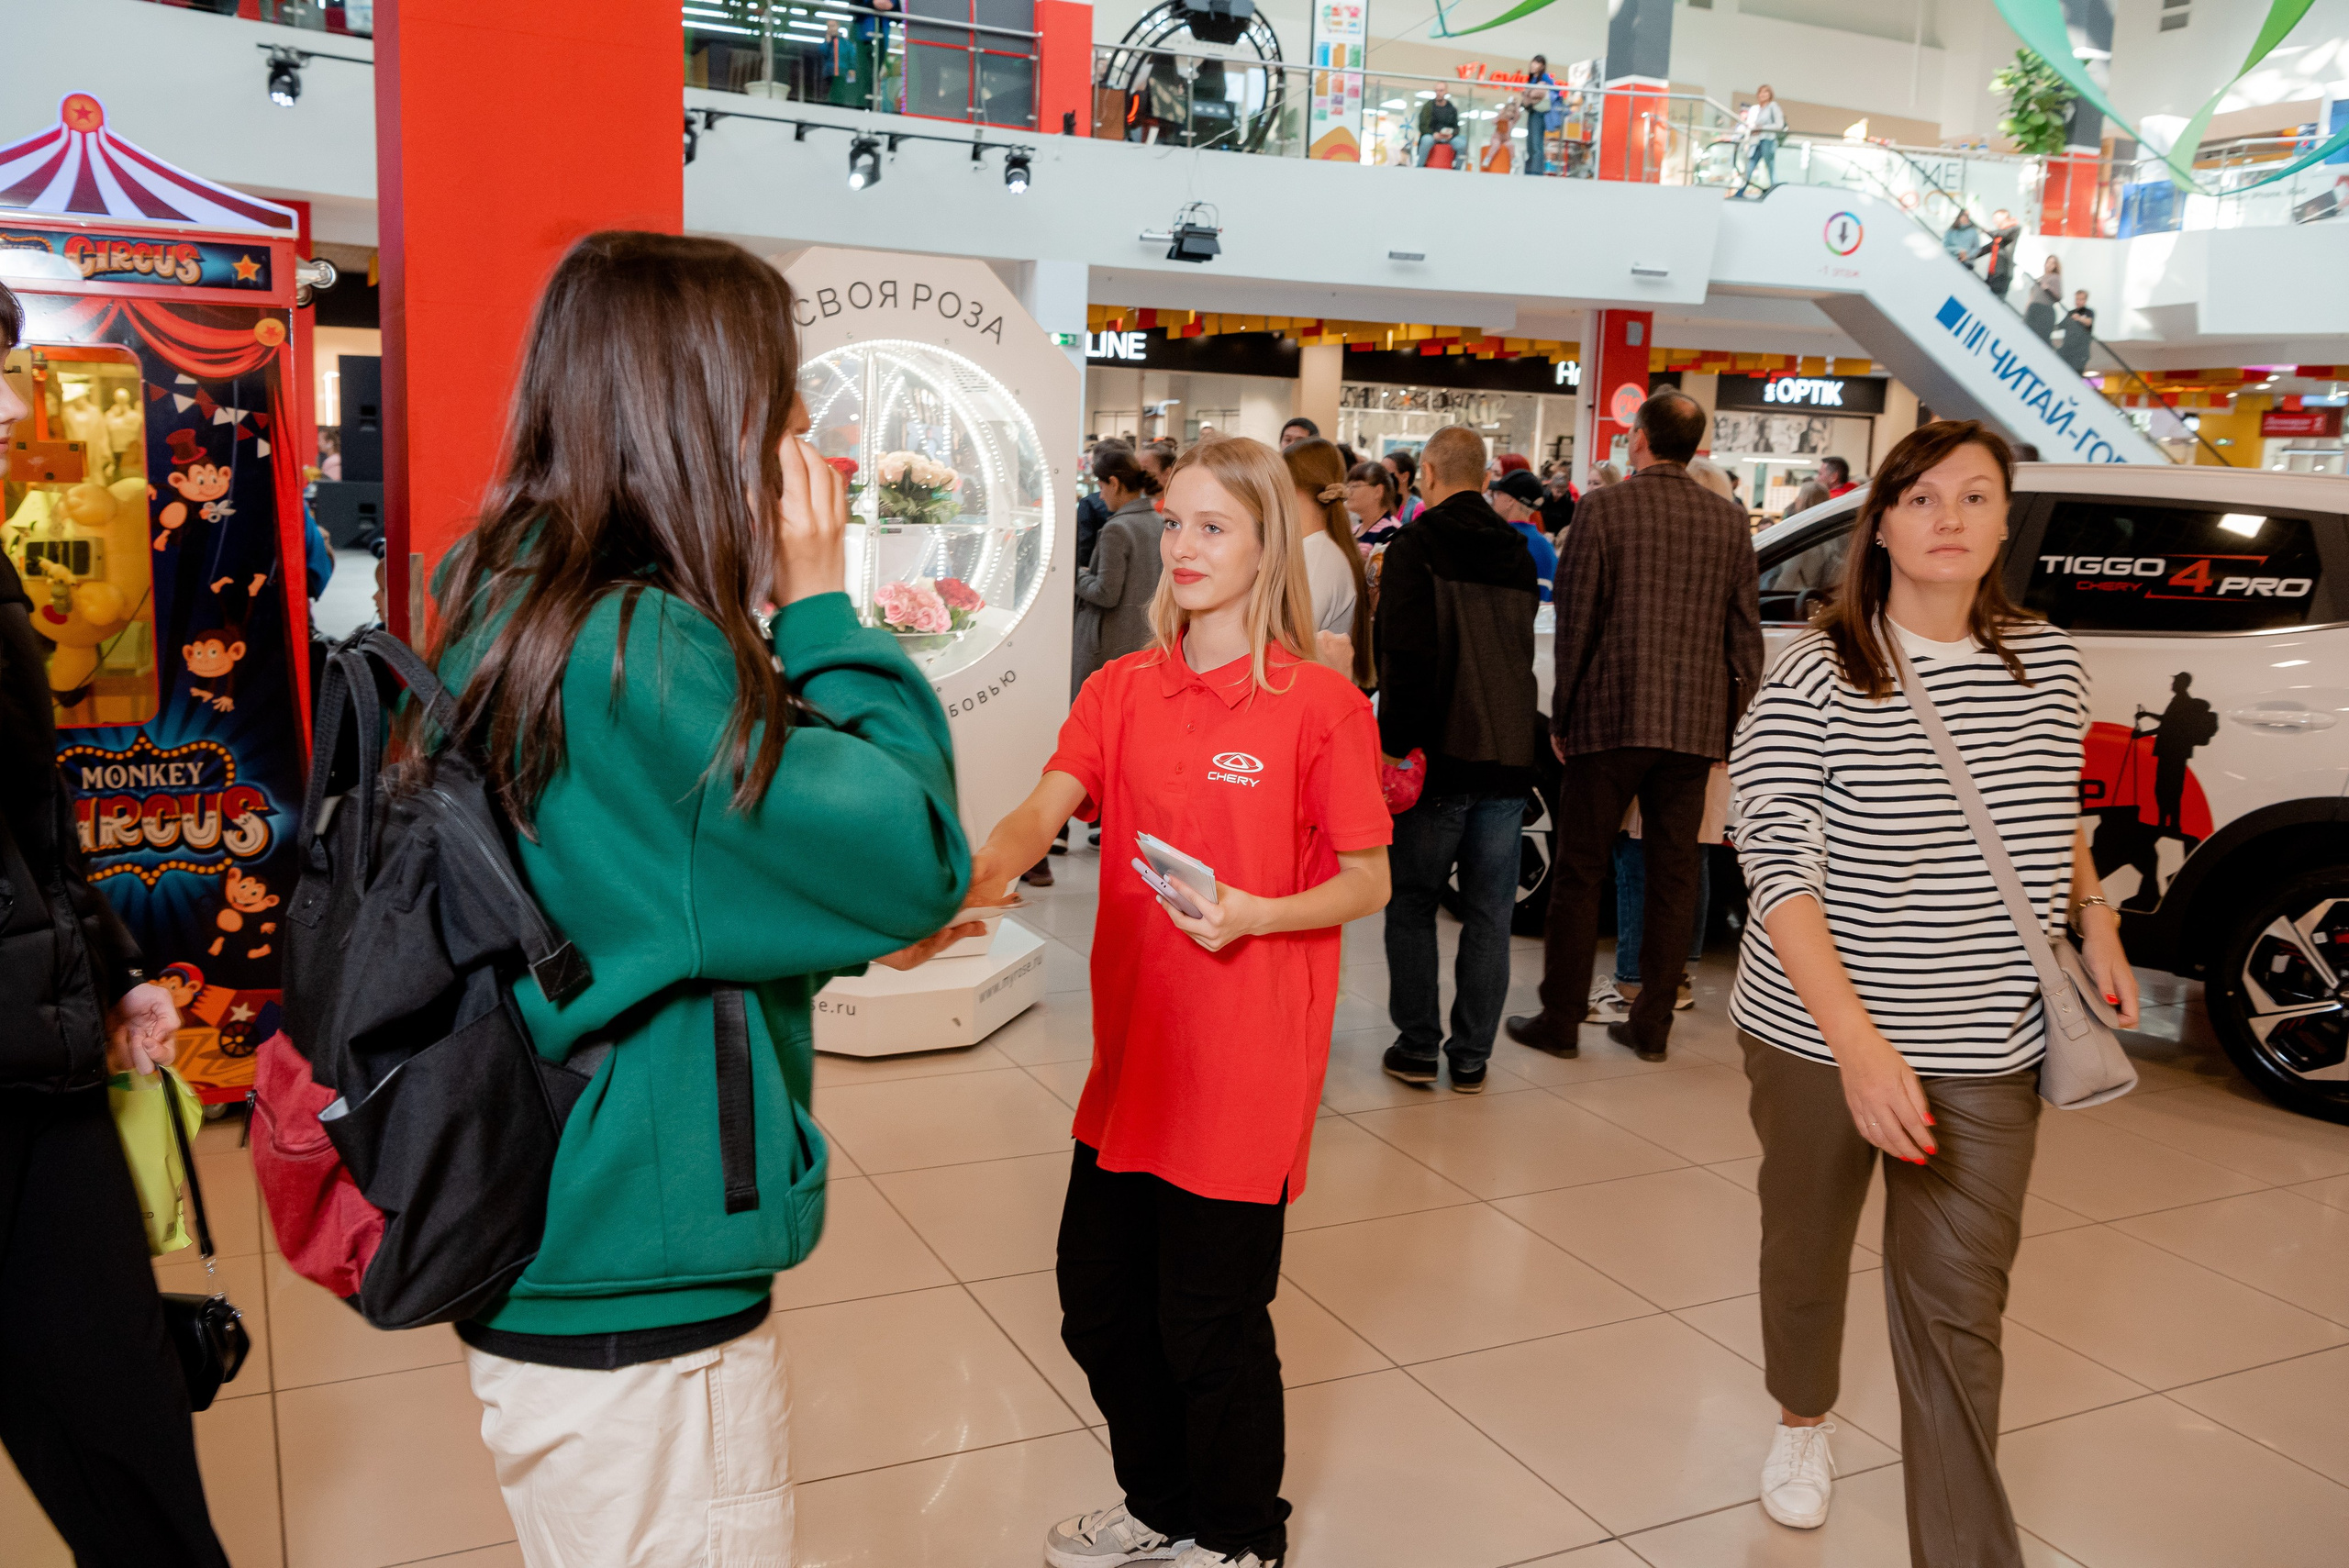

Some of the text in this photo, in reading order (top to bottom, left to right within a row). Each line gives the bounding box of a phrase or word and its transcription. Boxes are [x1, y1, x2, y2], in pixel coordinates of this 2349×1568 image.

[63, 235, 203, 285] CIRCUS
[792, 280, 1004, 345] СВОЯ РОЗА
[1085, 330, 1147, 361] LINE
[1776, 377, 1845, 406] OPTIK
[1989, 338, 2130, 462] ЧИТАЙ-ГО
[2039, 554, 2313, 597] TIGGO 4 PRO
[2076, 581, 2143, 592] CHERY
[948, 670, 1016, 717] БОВЬЮ
[81, 762, 204, 790] MONKEY
[1208, 771, 1261, 788] CHERY
